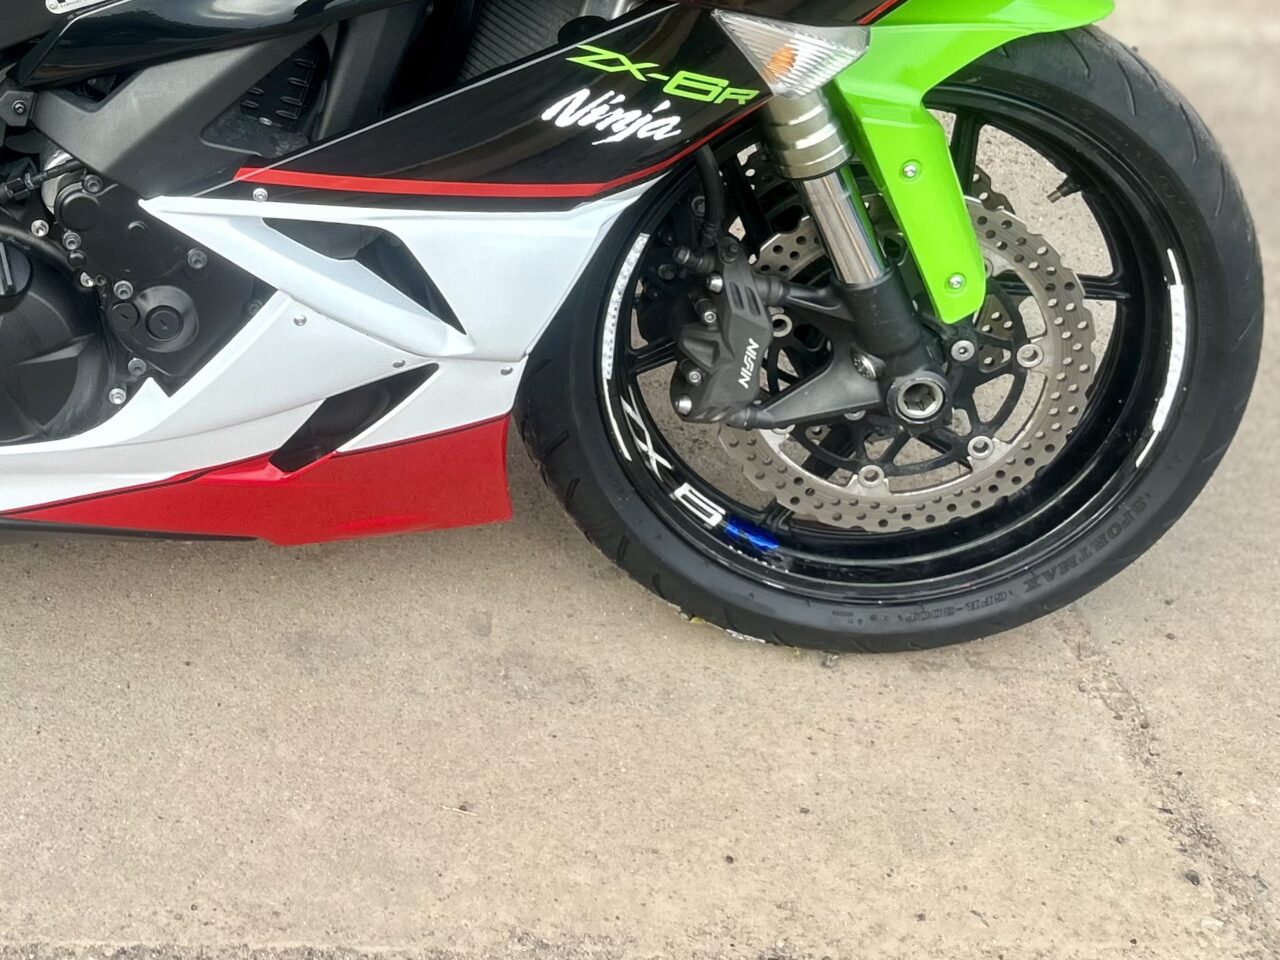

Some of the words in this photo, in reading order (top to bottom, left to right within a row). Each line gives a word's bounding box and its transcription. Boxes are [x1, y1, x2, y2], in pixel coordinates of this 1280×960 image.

[566, 44, 760, 104] ZX-6R
[541, 88, 682, 145] Ninja
[738, 337, 760, 389] NISSIN
[1022, 495, 1150, 594] SPORTMAX
